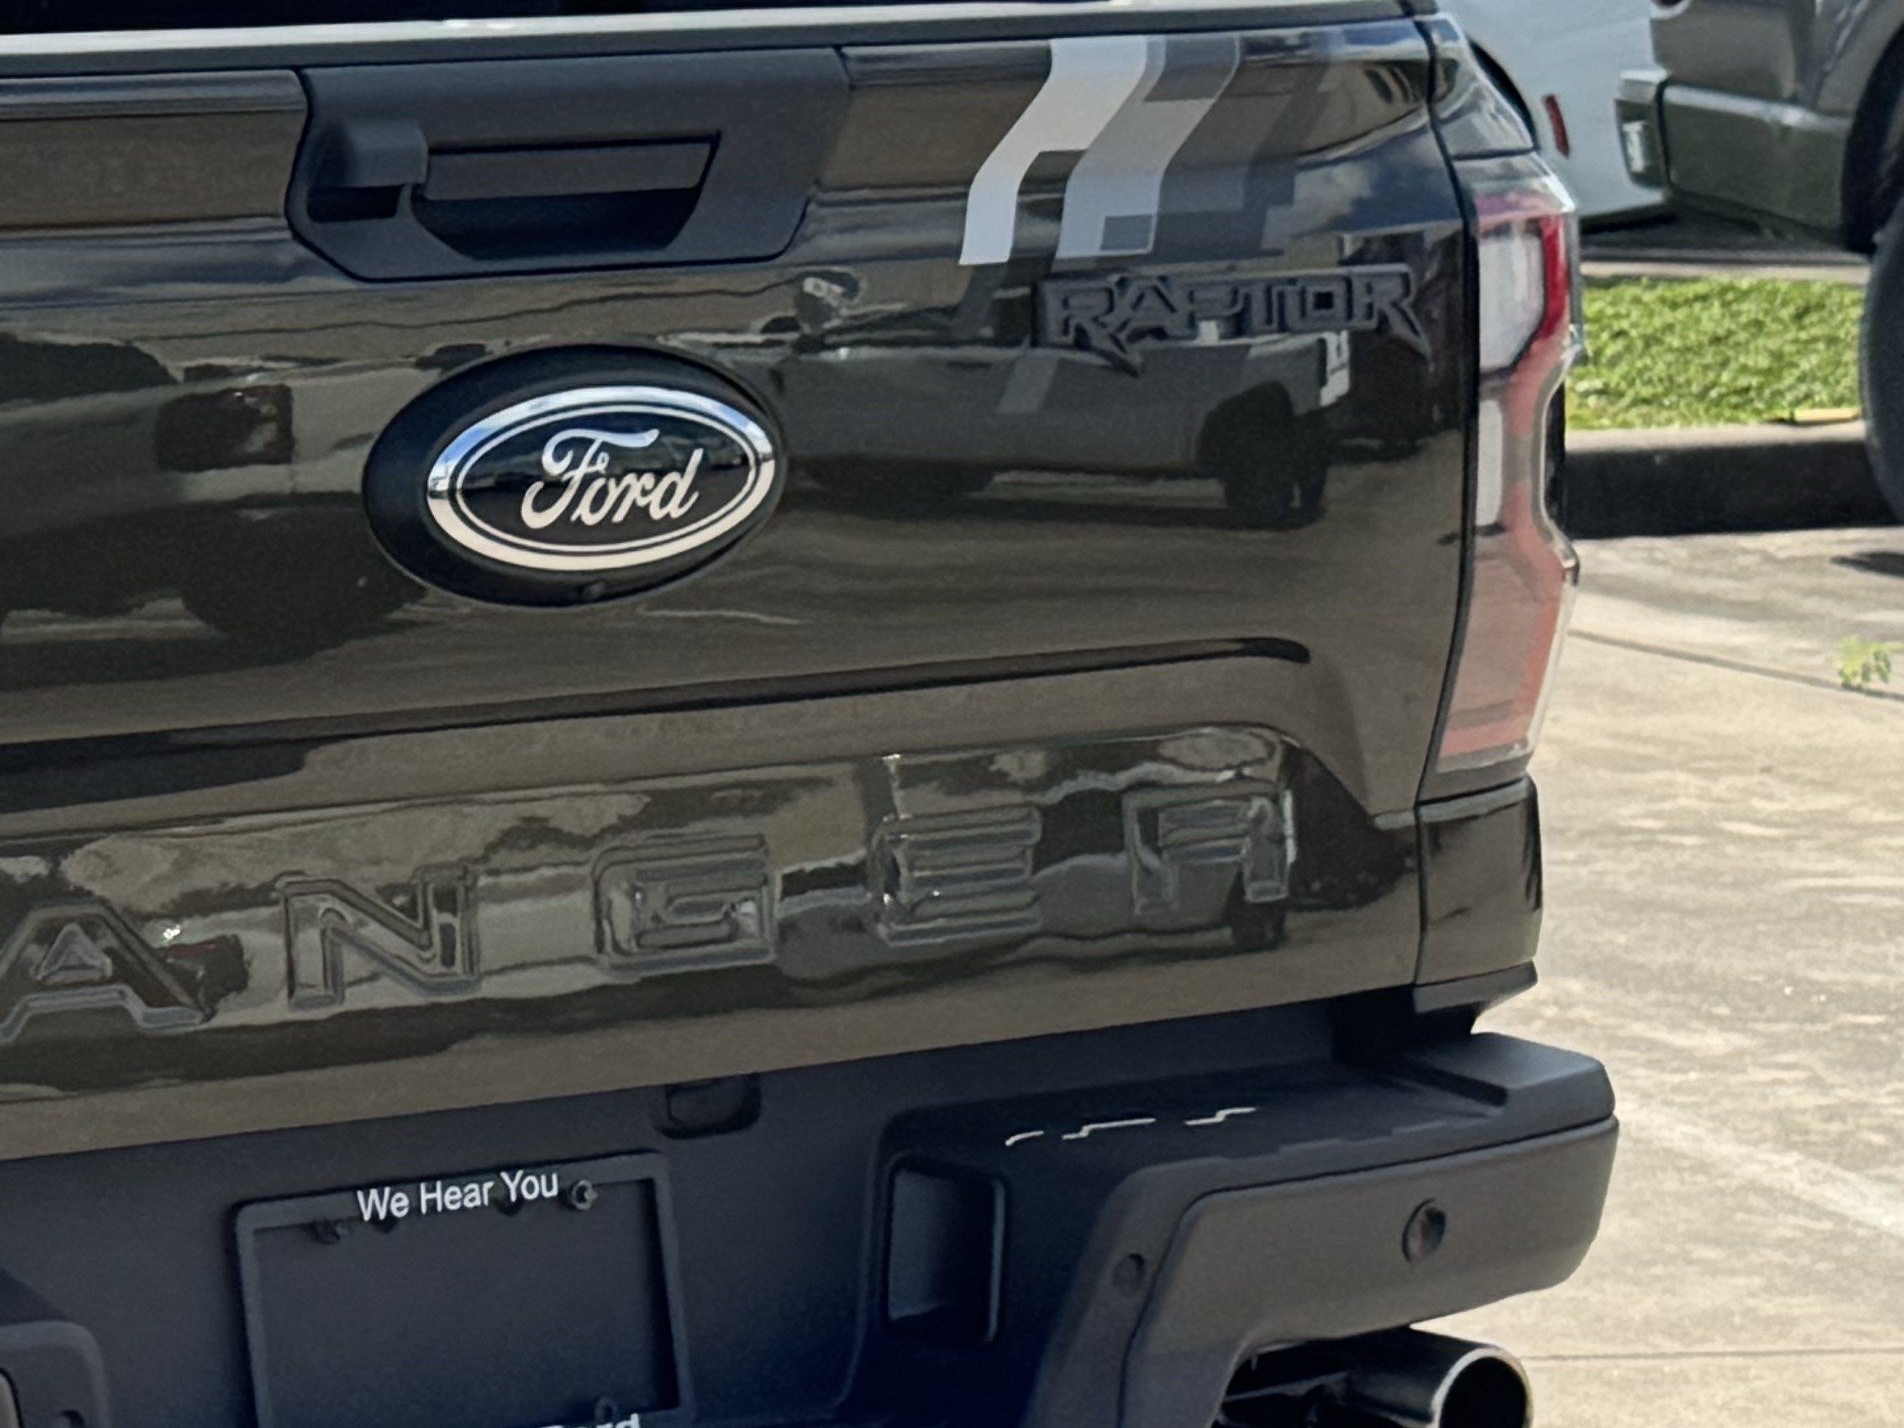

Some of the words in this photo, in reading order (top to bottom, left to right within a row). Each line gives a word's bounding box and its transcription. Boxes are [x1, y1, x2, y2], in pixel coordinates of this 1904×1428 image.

[1034, 264, 1436, 377] RAPTOR
[521, 428, 704, 529] Ford
[356, 1187, 410, 1222] We
[419, 1177, 494, 1215] Hear
[500, 1168, 559, 1203] You
